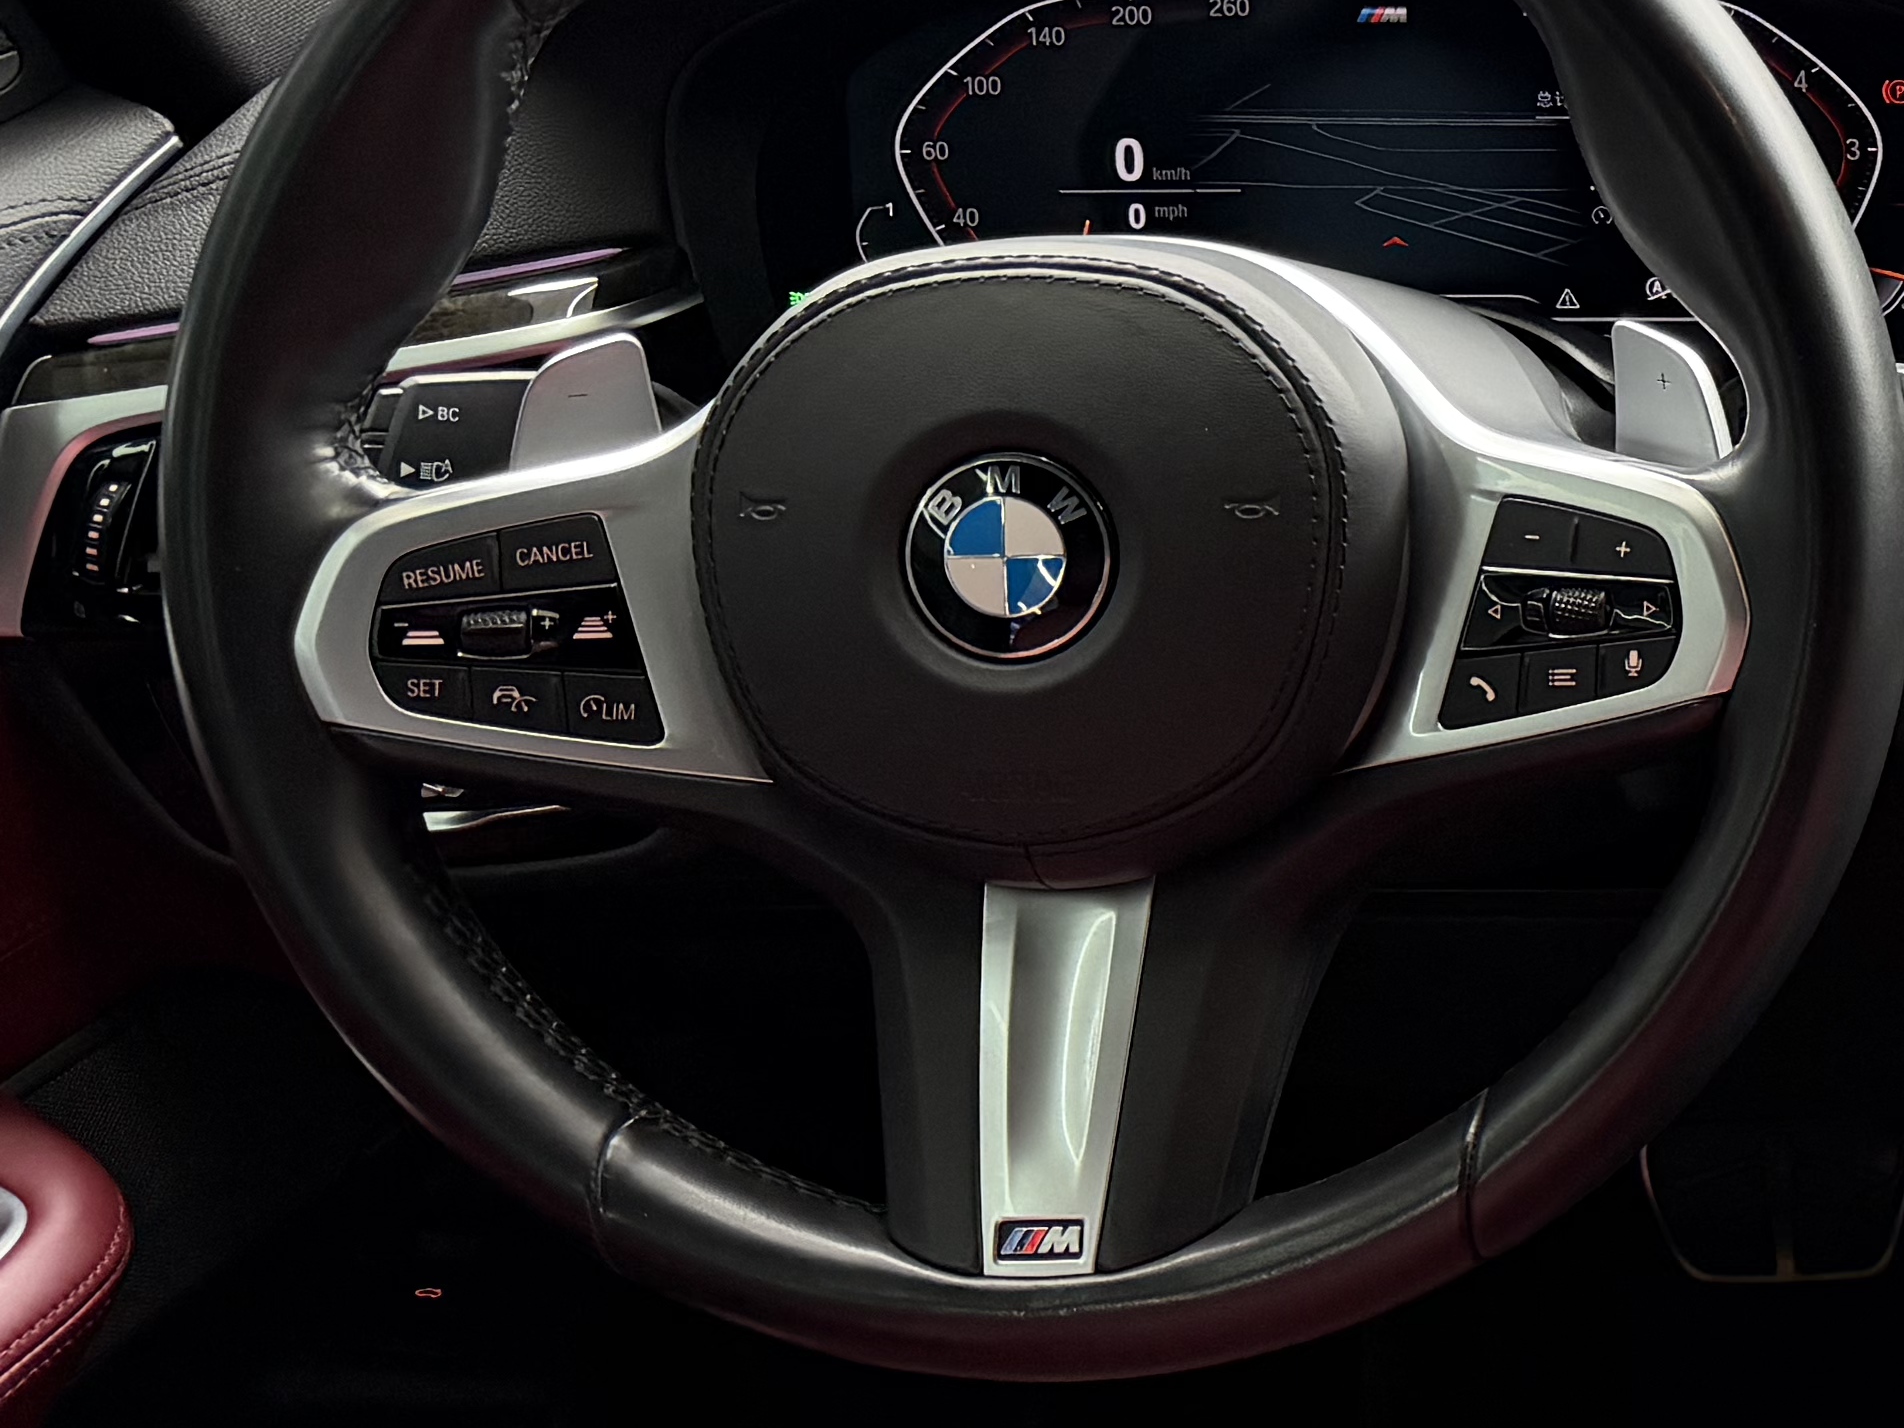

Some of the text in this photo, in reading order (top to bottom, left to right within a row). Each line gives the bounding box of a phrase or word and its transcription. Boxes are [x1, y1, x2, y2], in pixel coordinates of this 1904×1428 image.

[1111, 5, 1152, 26] 200
[1027, 26, 1066, 47] 140
[963, 75, 1001, 96] 100
[1793, 71, 1808, 93] 4
[922, 141, 949, 161] 60
[1115, 137, 1191, 181] 0 km/h
[1845, 139, 1861, 161] 3
[884, 202, 894, 217] 1
[953, 208, 979, 228] 40
[1128, 203, 1188, 229] 0 mph
[437, 406, 460, 422] BC
[928, 465, 1087, 525] BMW
[516, 540, 594, 567] CANCEL
[402, 559, 485, 590] RESUME
[407, 678, 443, 698] SET
[601, 702, 636, 721] LIM
